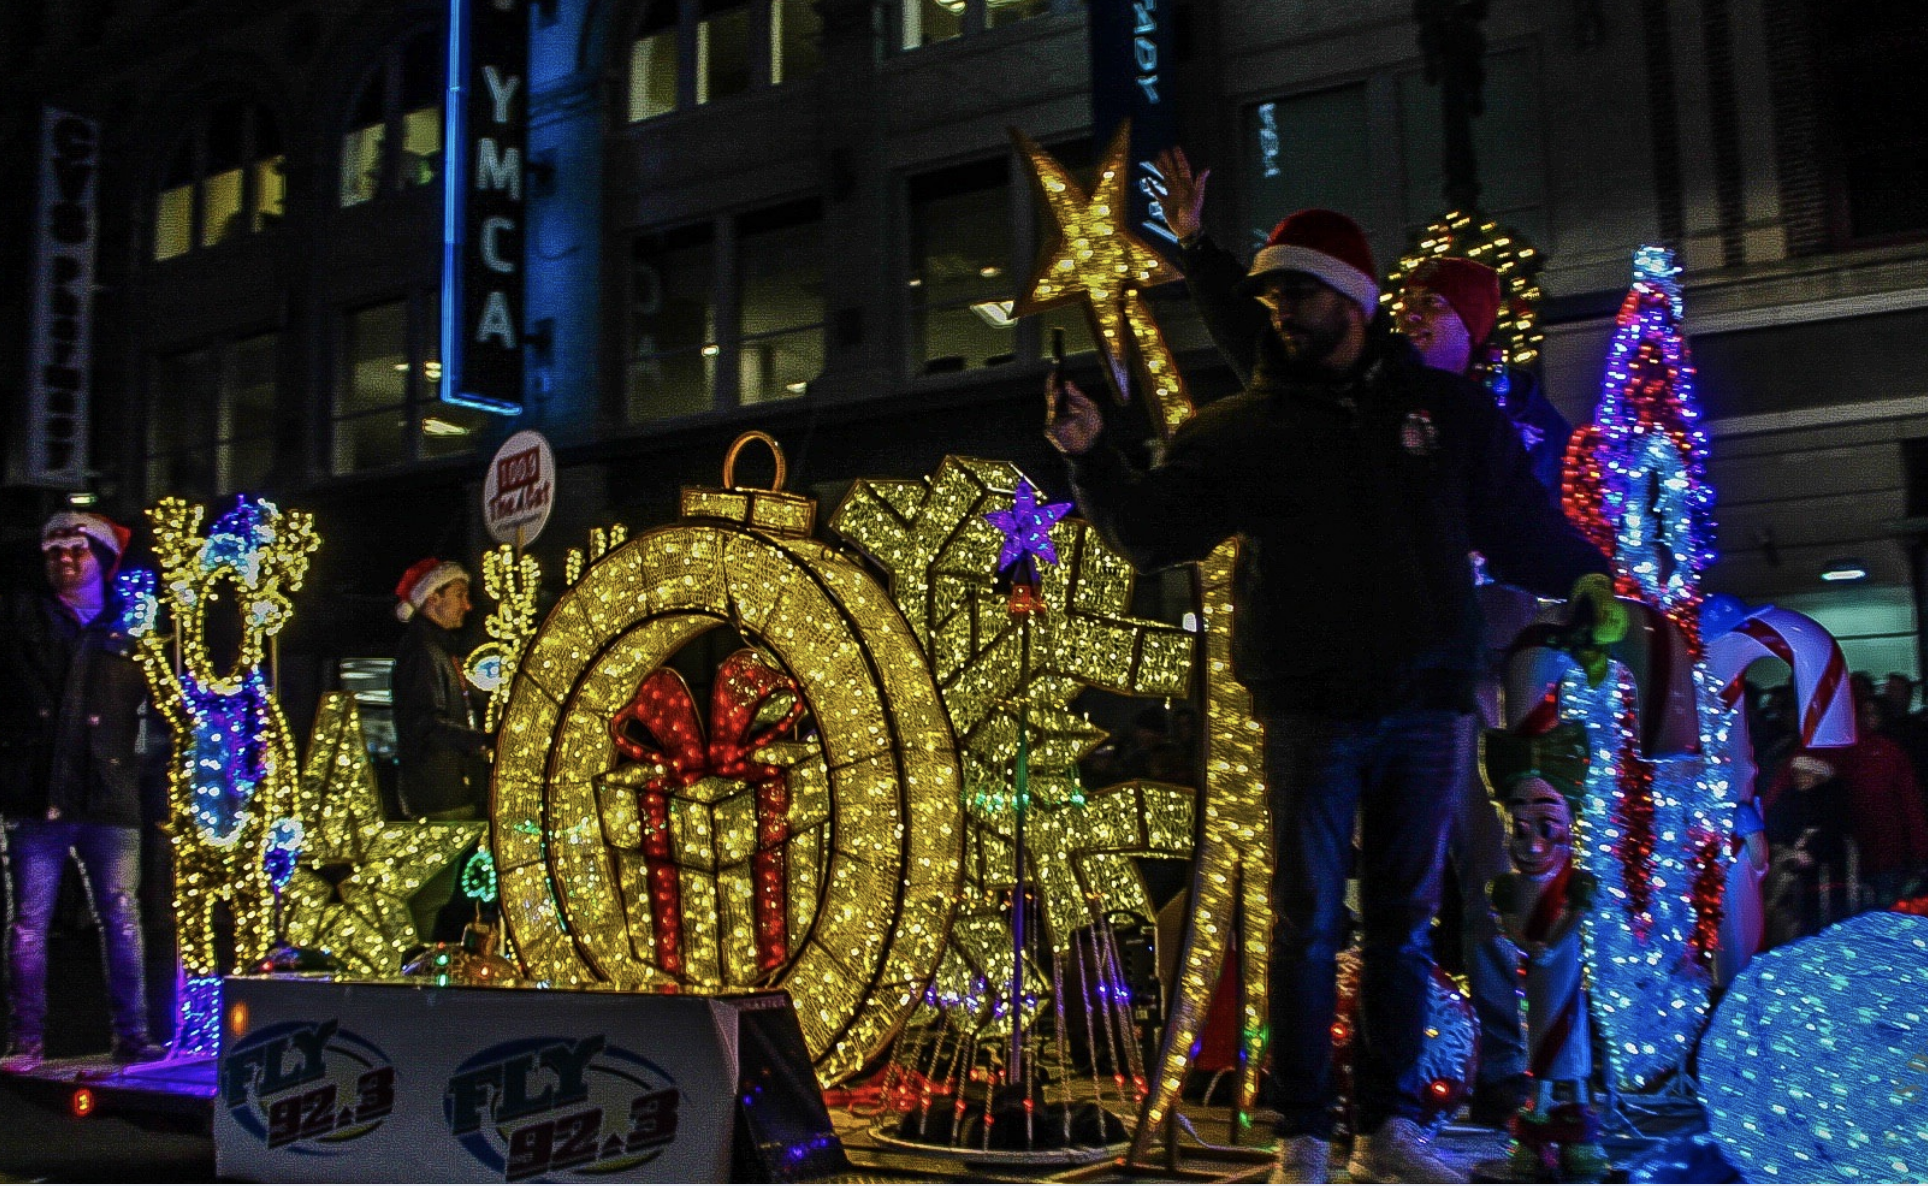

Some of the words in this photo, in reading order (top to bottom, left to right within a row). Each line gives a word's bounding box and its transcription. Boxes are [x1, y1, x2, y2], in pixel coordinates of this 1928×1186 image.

[475, 65, 522, 351] YMCA
[226, 1018, 338, 1109] FLY
[449, 1035, 605, 1136] FLY
